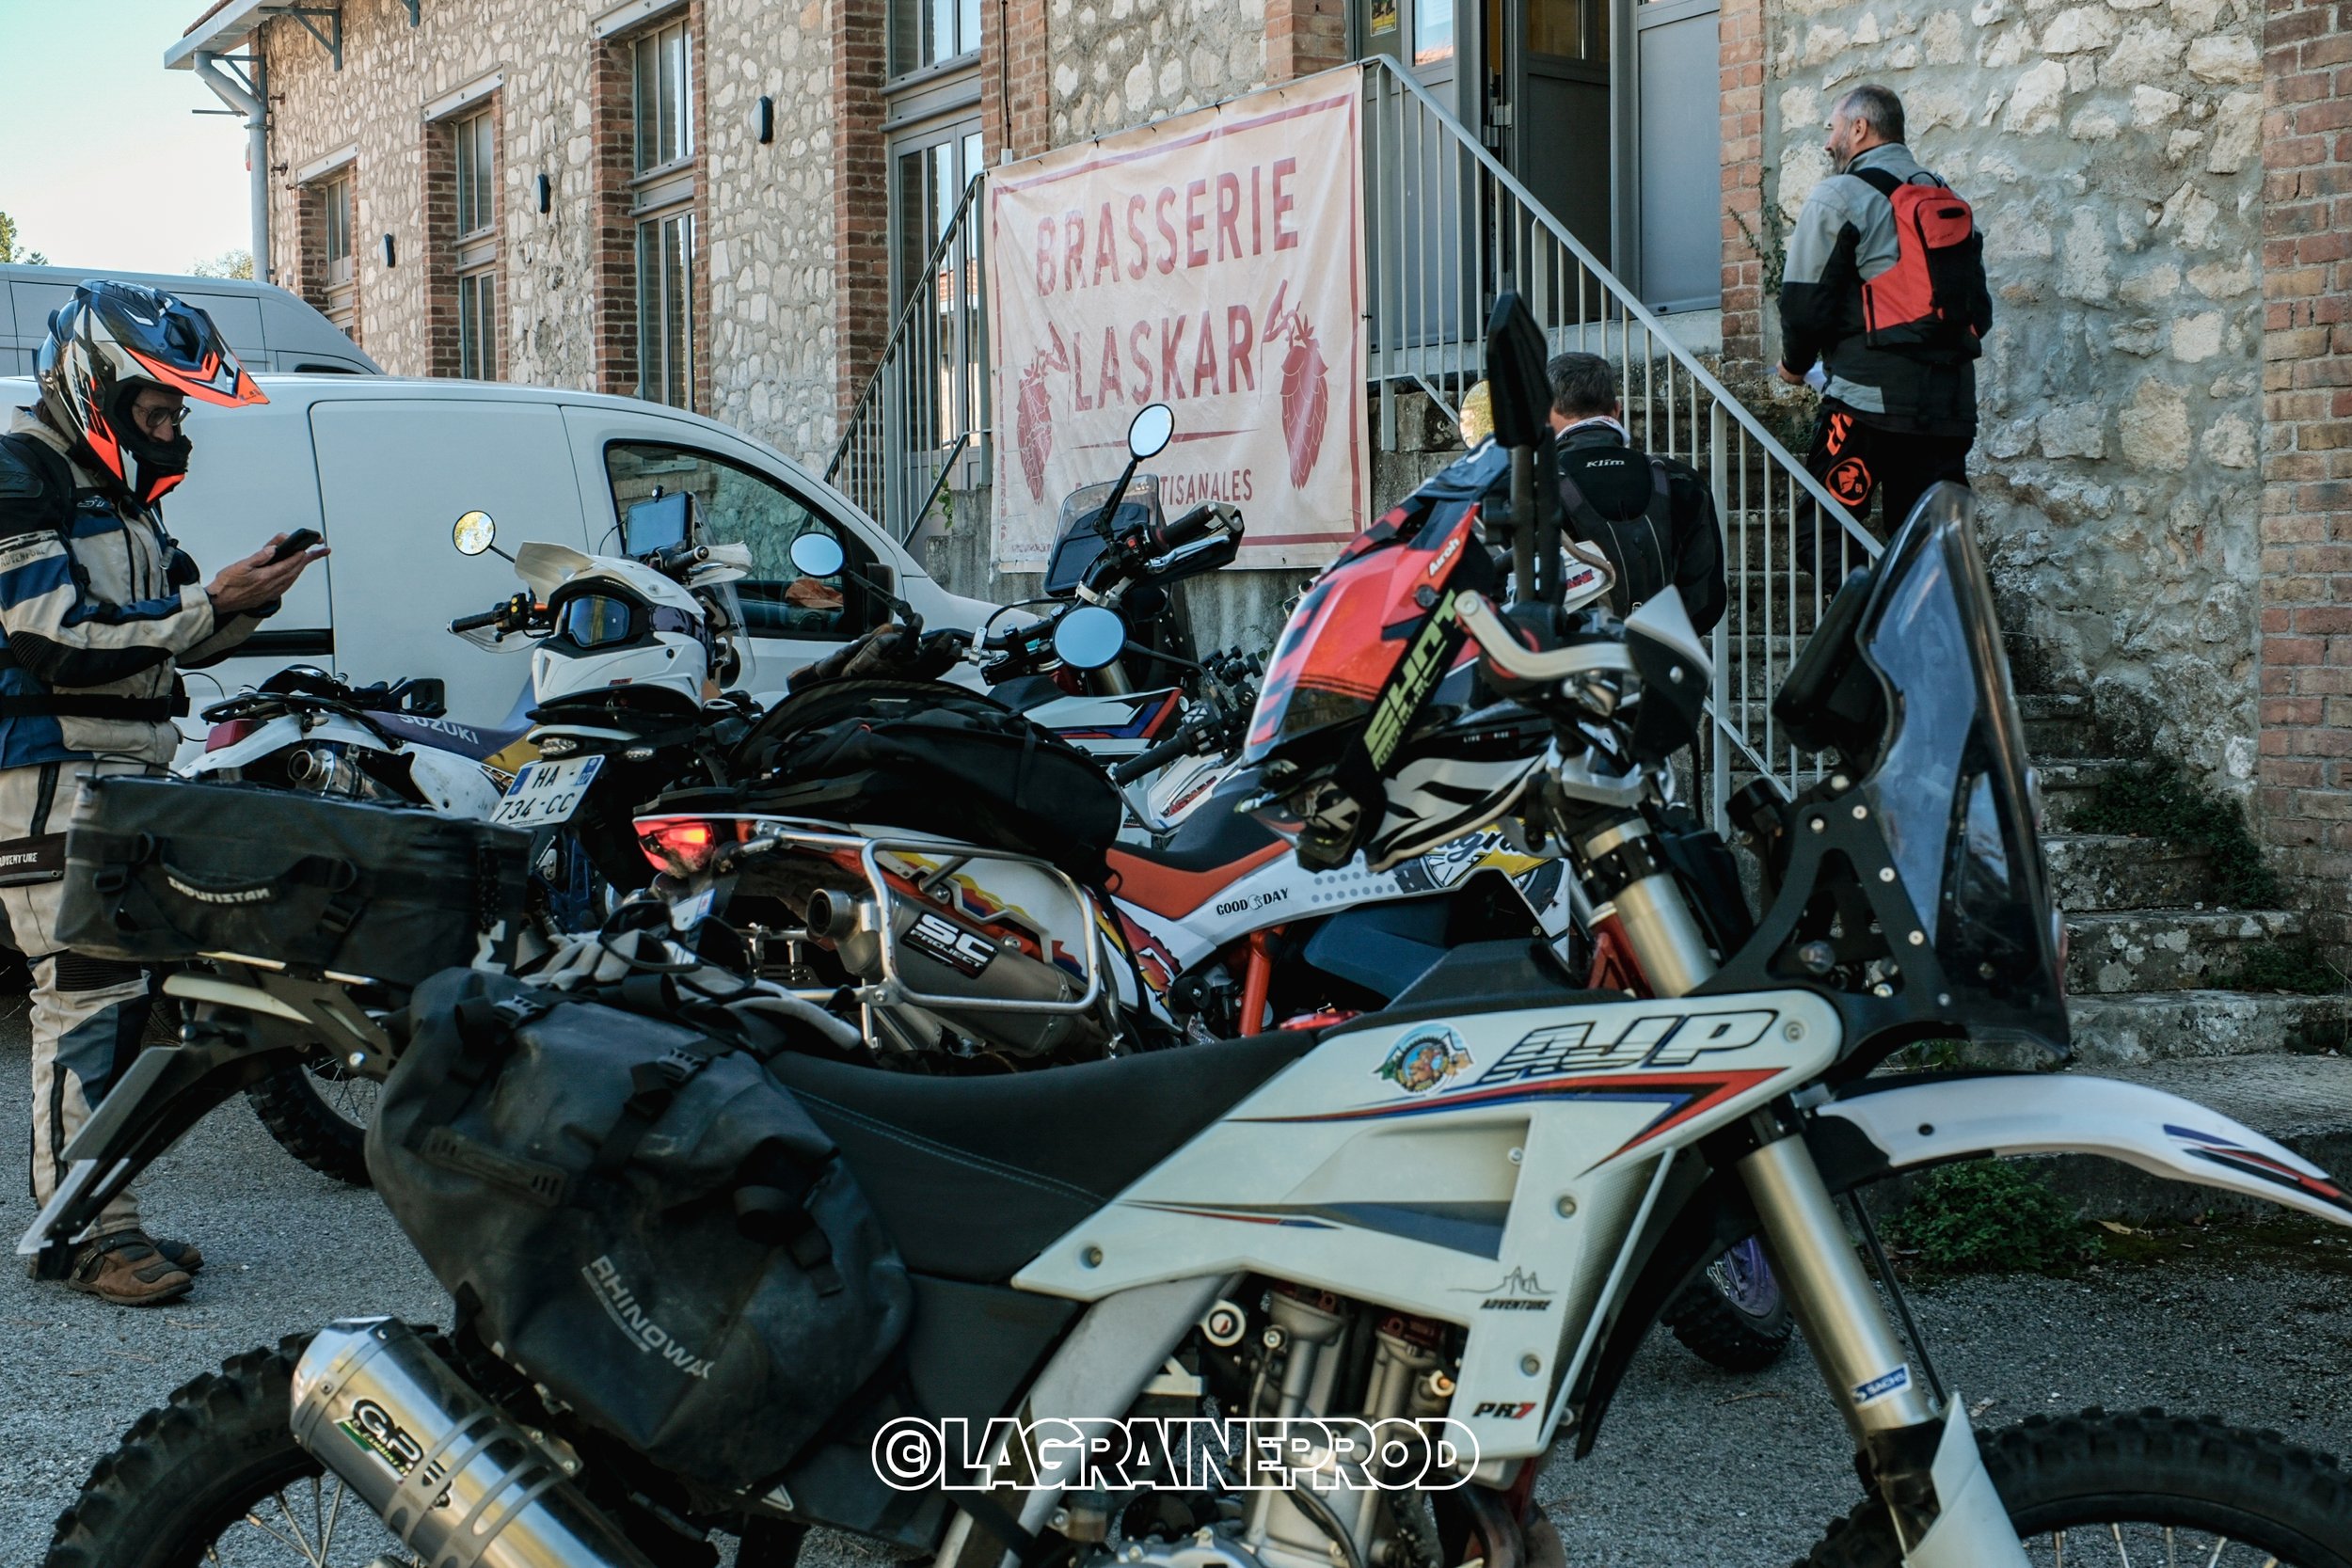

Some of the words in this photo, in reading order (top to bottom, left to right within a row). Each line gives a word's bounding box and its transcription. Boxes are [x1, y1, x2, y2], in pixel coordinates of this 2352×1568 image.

[1036, 156, 1298, 297] BRASSERIE
[1073, 304, 1255, 412] LASKAR
[1585, 458, 1625, 468] Klim
[1428, 536, 1460, 577] Airoh
[396, 713, 480, 745] SUZUKI
[0, 852, 39, 867] DVENTURE
[1216, 898, 1248, 916] GOOD
[1263, 887, 1289, 906] DAY
[910, 928, 985, 968] PROJECT
[914, 913, 996, 964] SC
[1471, 1401, 1537, 1420] PR7
